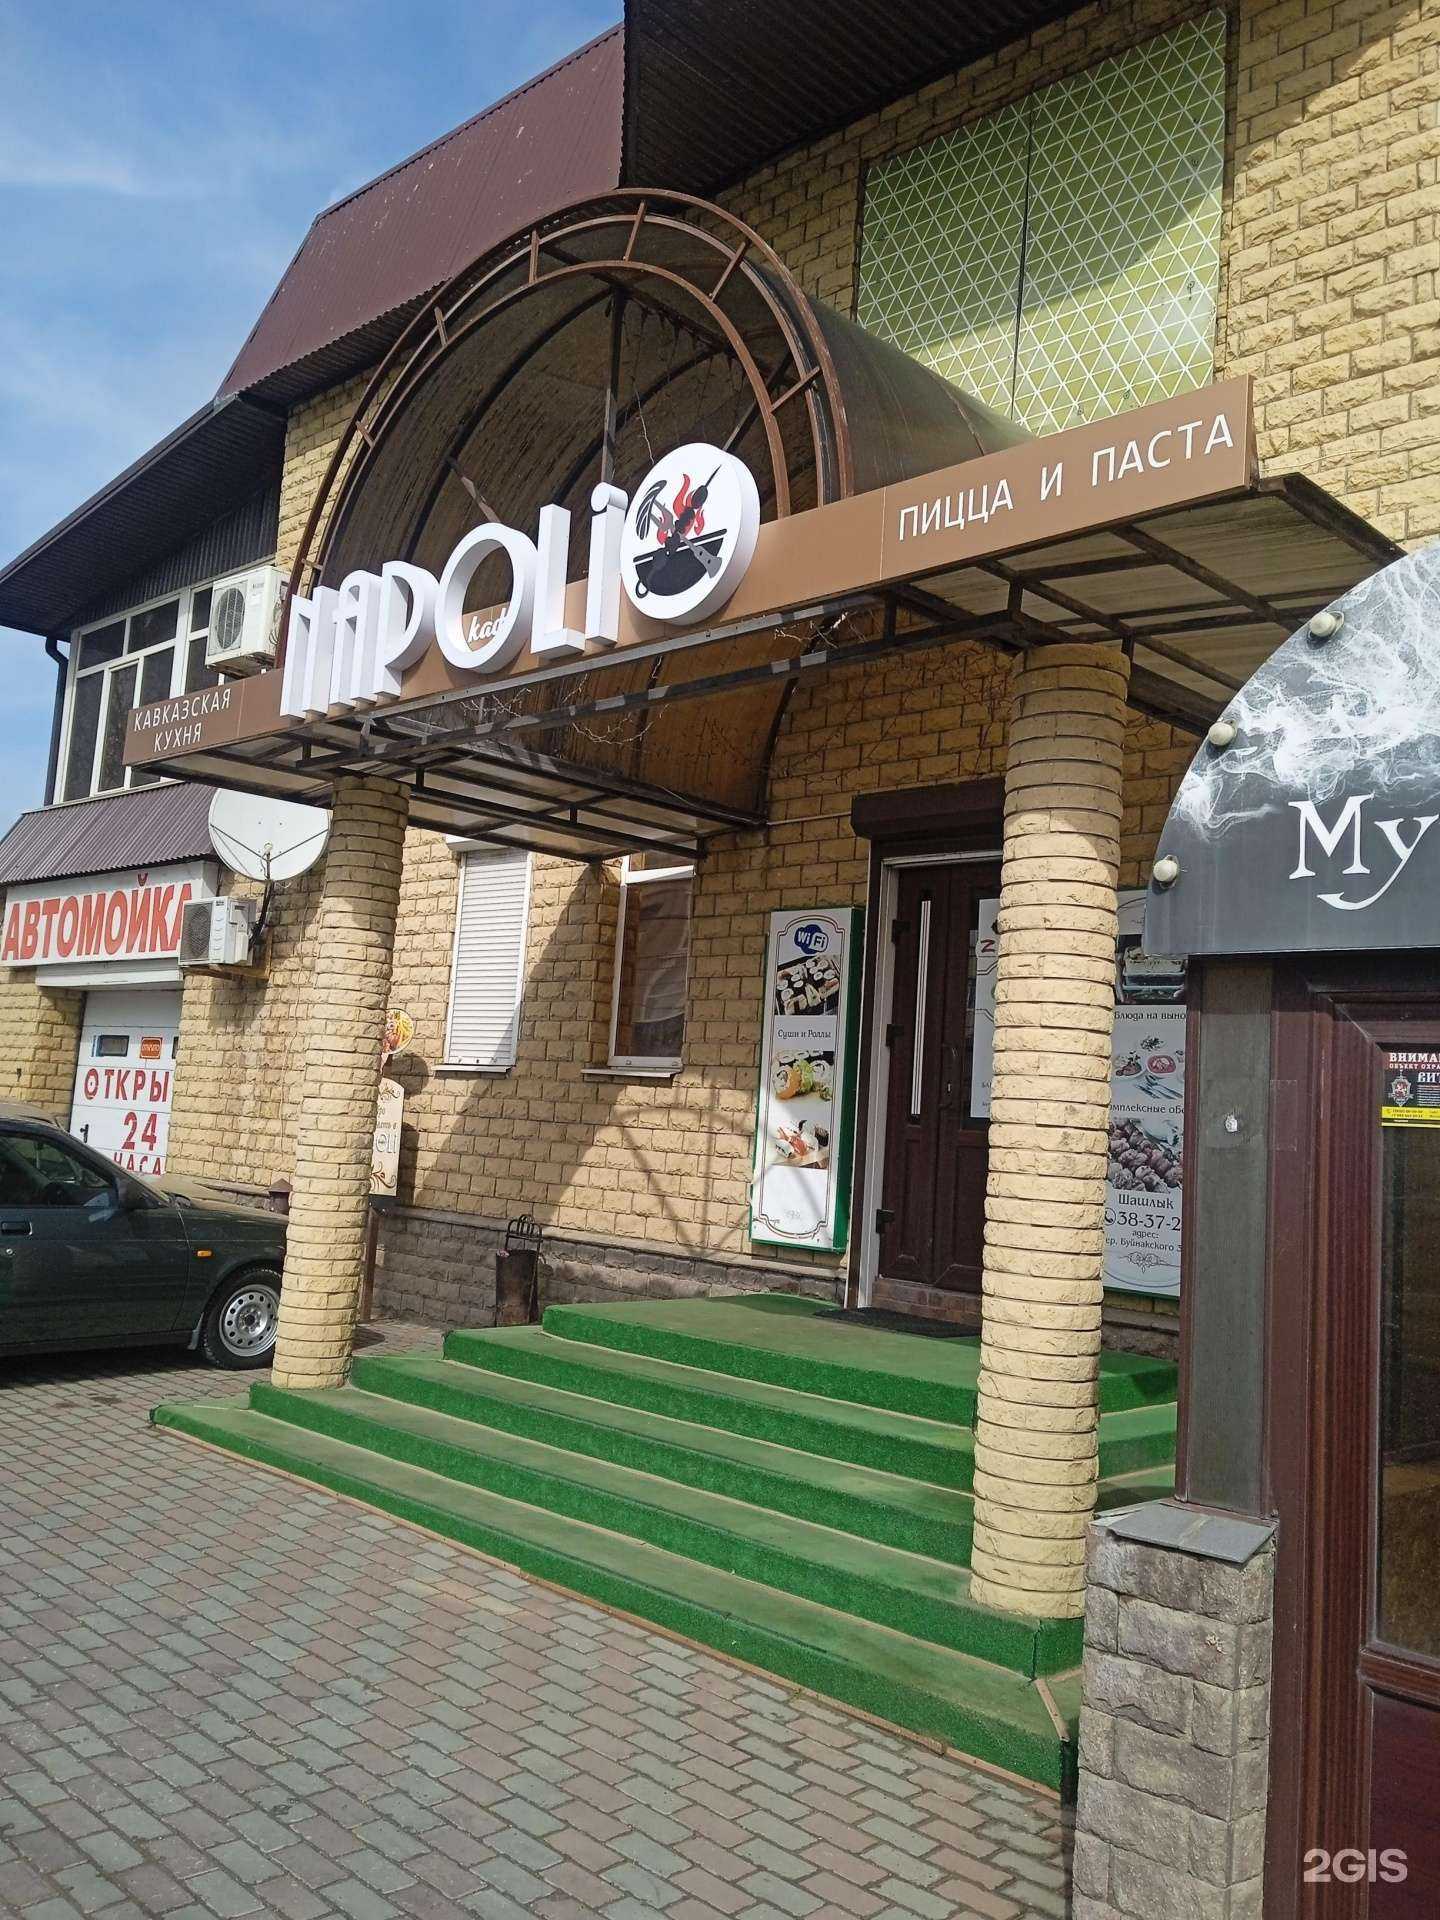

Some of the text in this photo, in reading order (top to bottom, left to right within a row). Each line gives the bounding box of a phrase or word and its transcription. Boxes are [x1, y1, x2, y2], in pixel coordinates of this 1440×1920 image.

[899, 413, 1235, 542] ПИЦЦА И ПАСТА
[134, 688, 231, 732] КАВКАЗСКАЯ
[154, 722, 202, 753] КУХНЯ
[1, 872, 193, 961] АВТОМОЙКА
[1114, 1011, 1144, 1021] Блюда
[1147, 1012, 1158, 1020] на
[777, 1028, 800, 1040] Суши
[807, 1028, 832, 1039] Роллы
[1389, 1052, 1440, 1063] ВНИМА
[83, 1067, 170, 1103] ОТКРЫ
[121, 1111, 158, 1151] 24
[113, 1151, 162, 1176] ЧАСА
[1118, 1193, 1174, 1209] Шашлык
